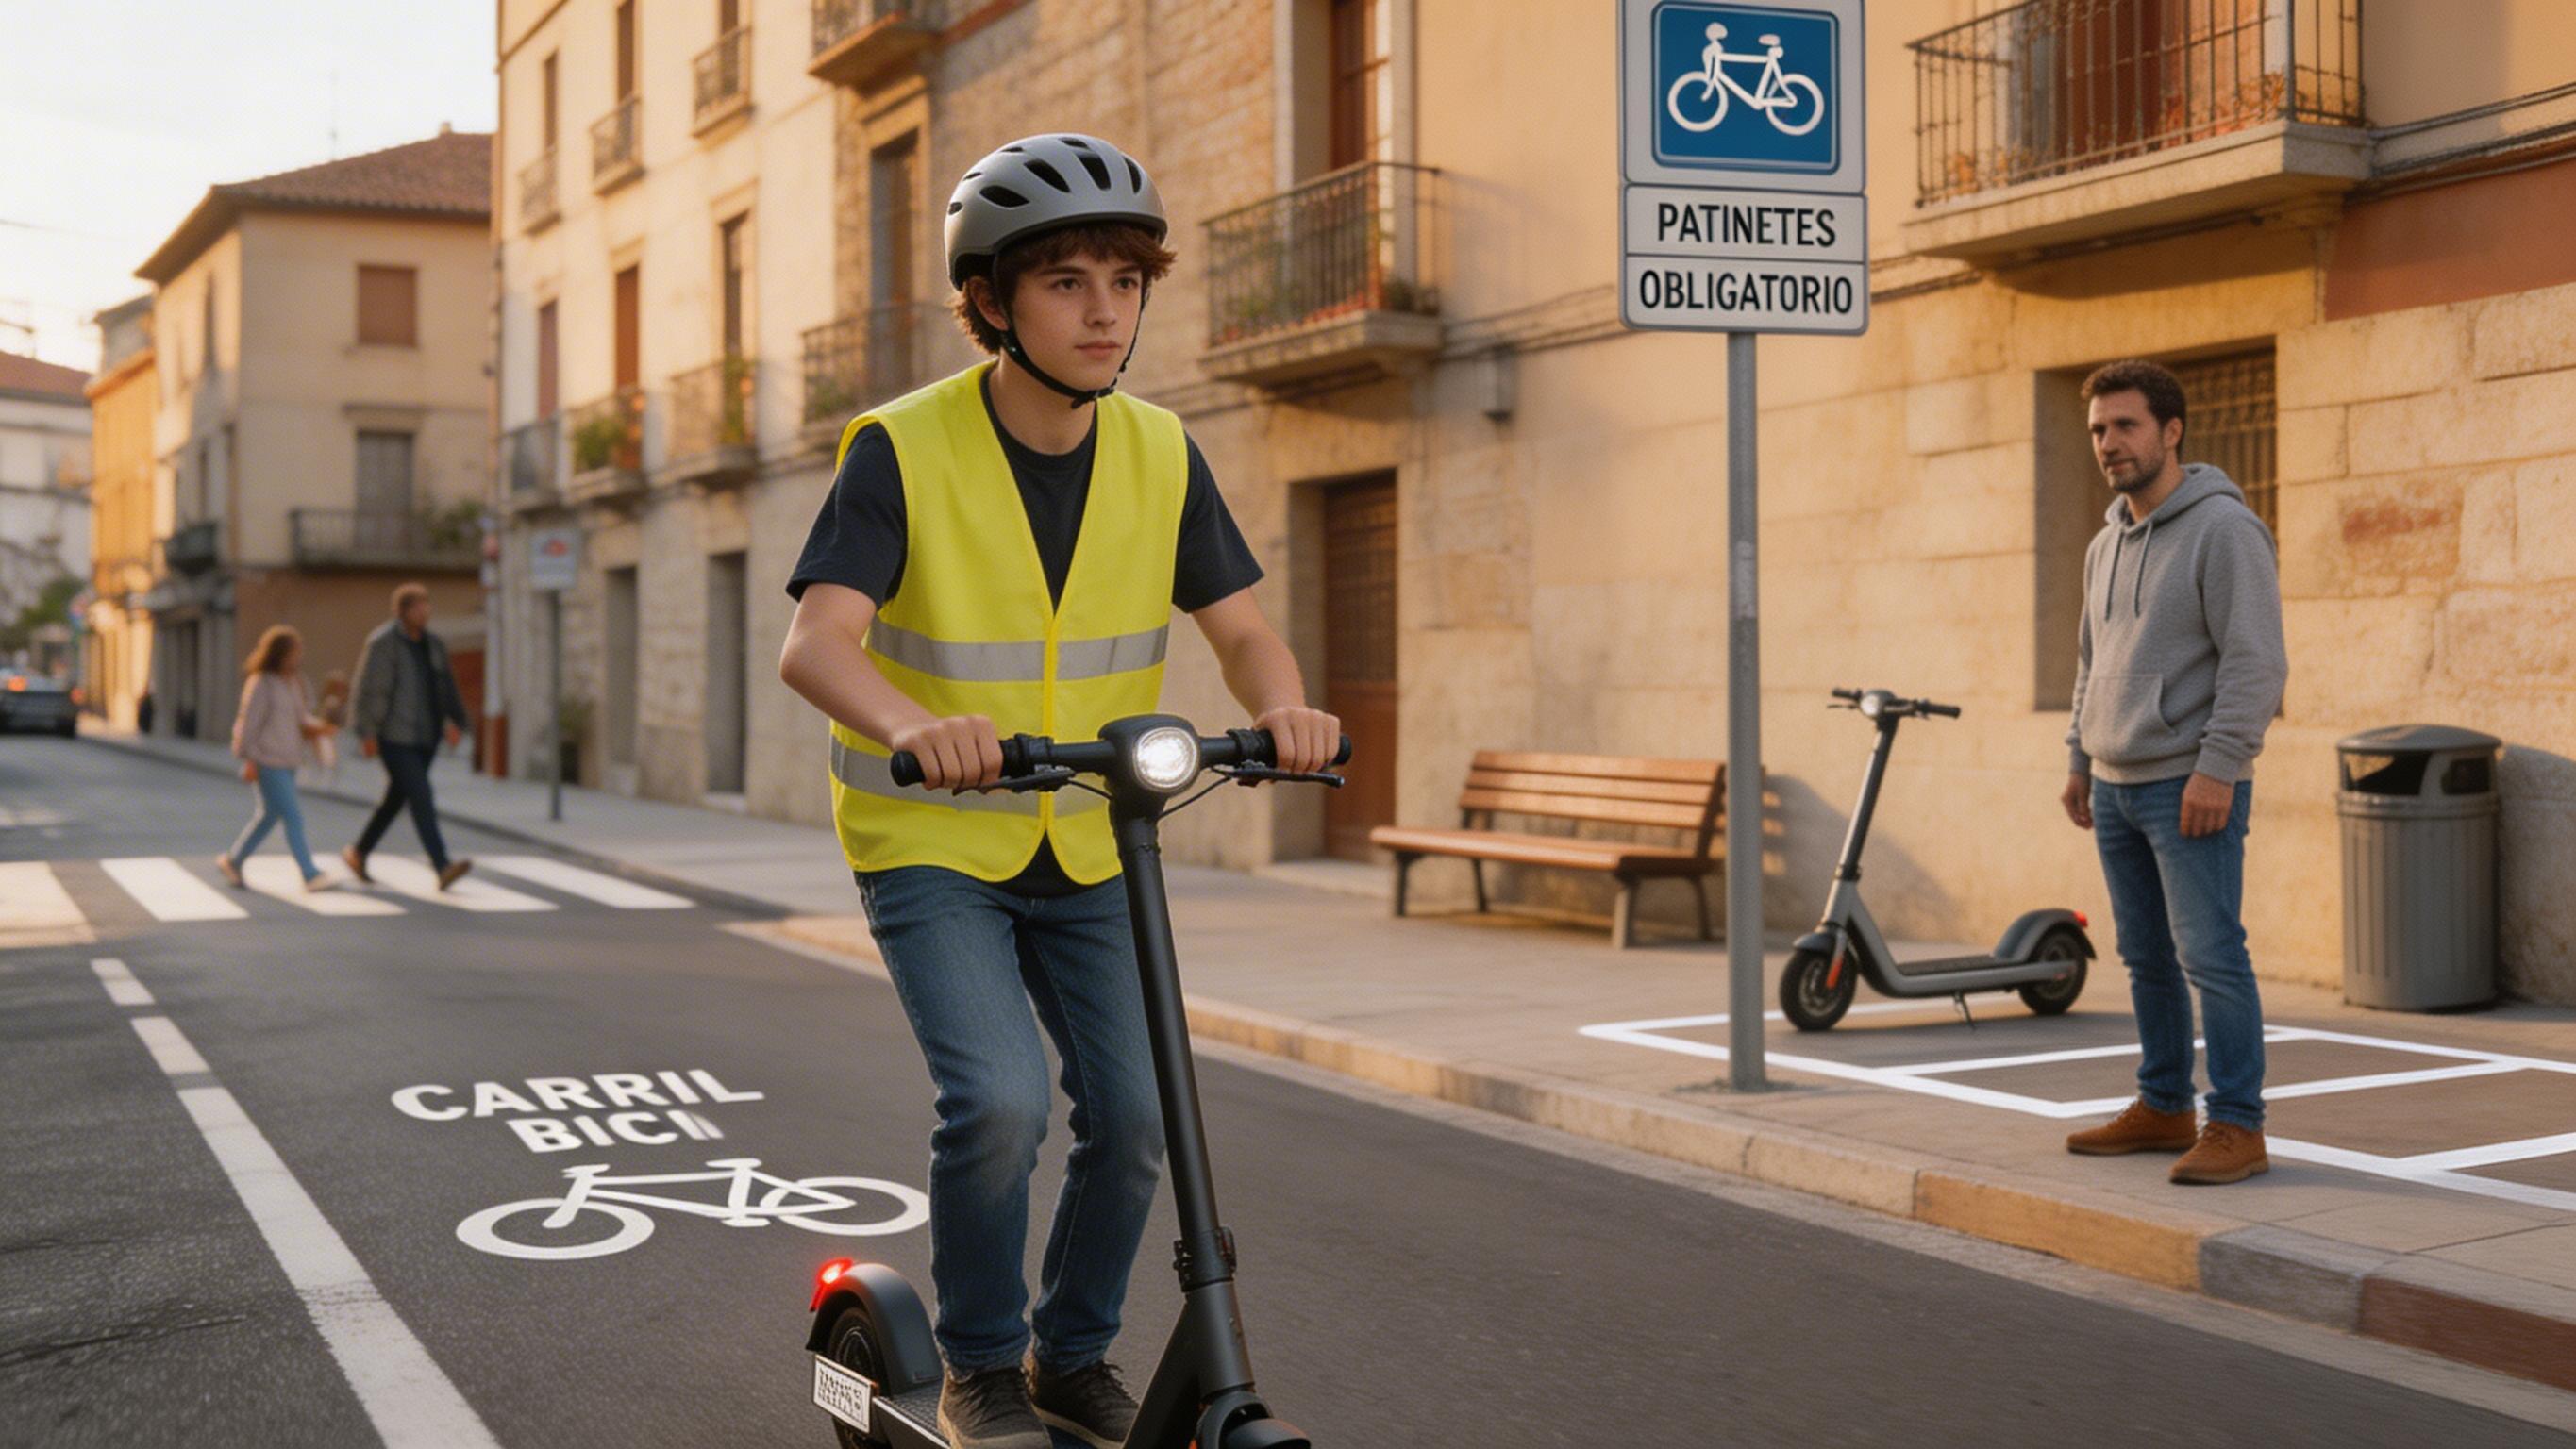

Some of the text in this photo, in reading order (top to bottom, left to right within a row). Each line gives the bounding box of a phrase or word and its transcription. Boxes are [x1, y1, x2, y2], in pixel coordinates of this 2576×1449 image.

[1657, 202, 1836, 248] PATINETES
[1639, 269, 1853, 315] OBLIGATORIO
[391, 1069, 764, 1121] CARRIL
